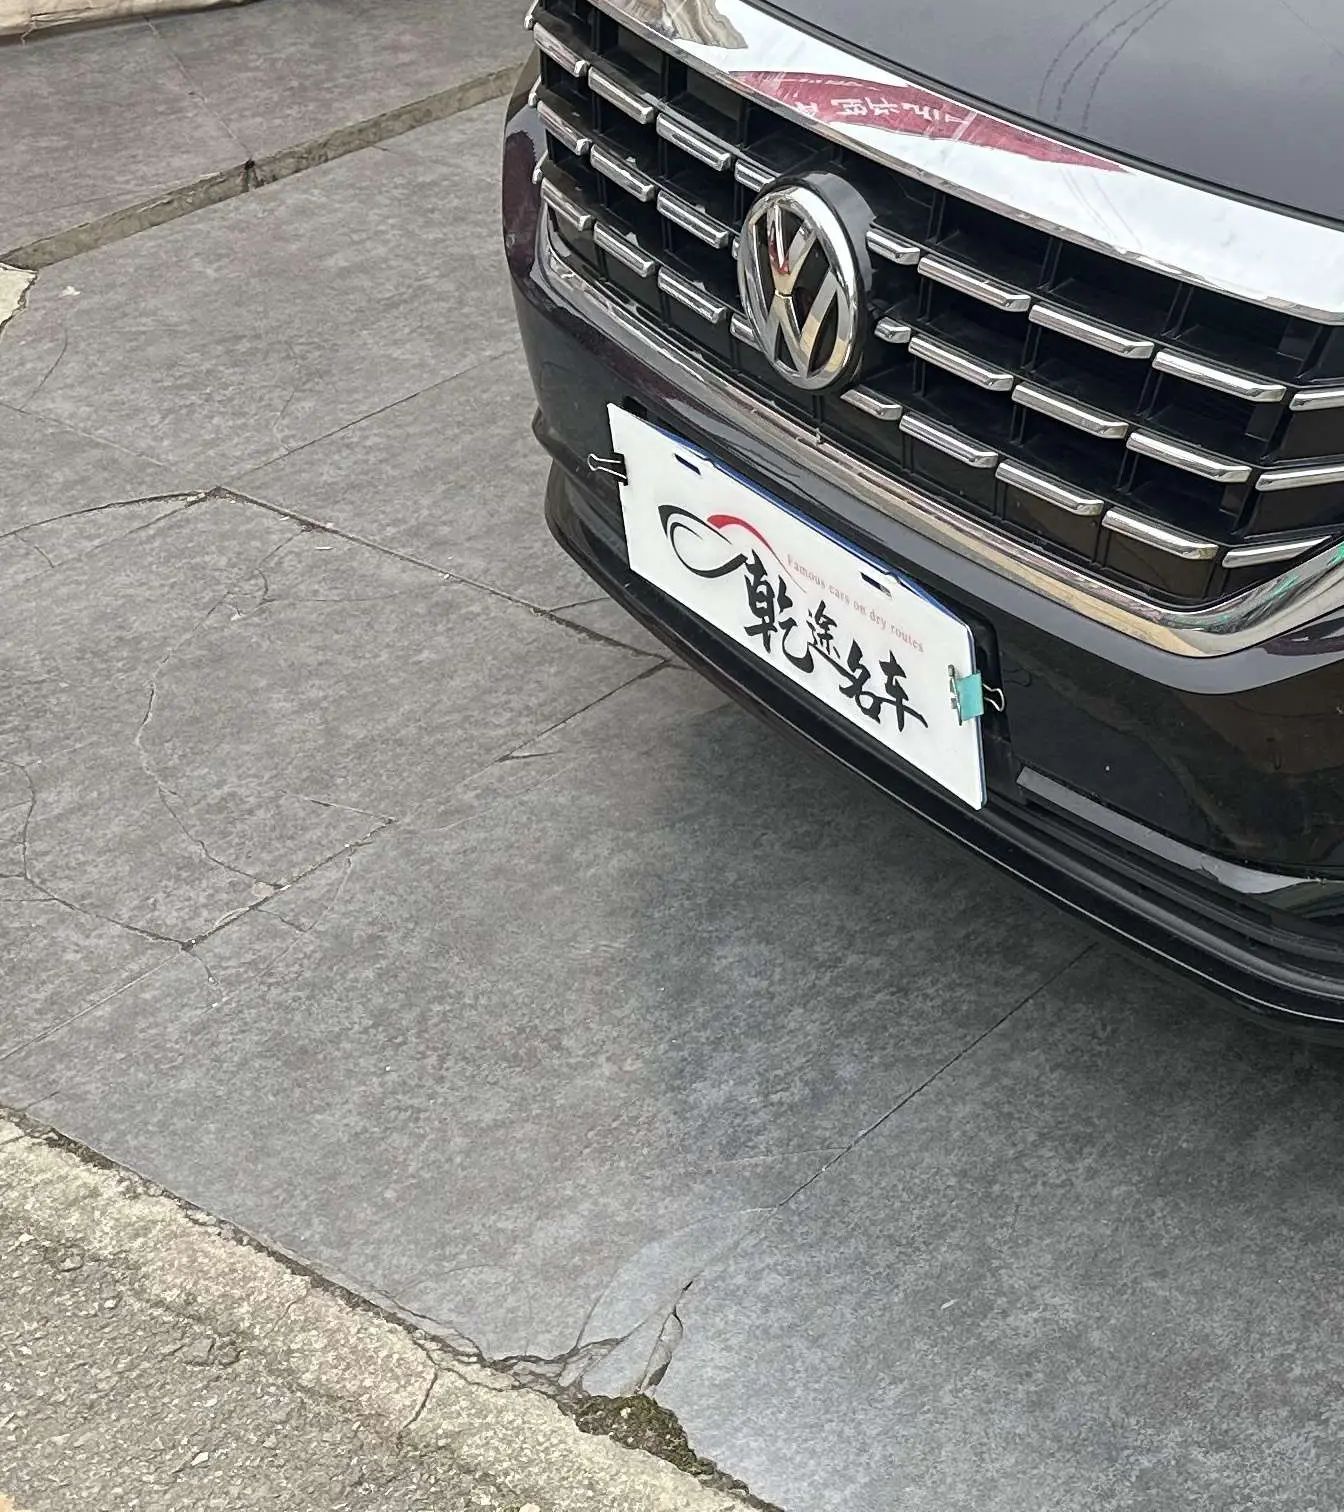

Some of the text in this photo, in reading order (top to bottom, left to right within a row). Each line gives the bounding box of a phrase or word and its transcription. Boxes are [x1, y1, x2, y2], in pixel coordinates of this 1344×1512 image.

[743, 549, 929, 732] 乾途名车
[786, 553, 924, 653] Famous cars on dry routes
